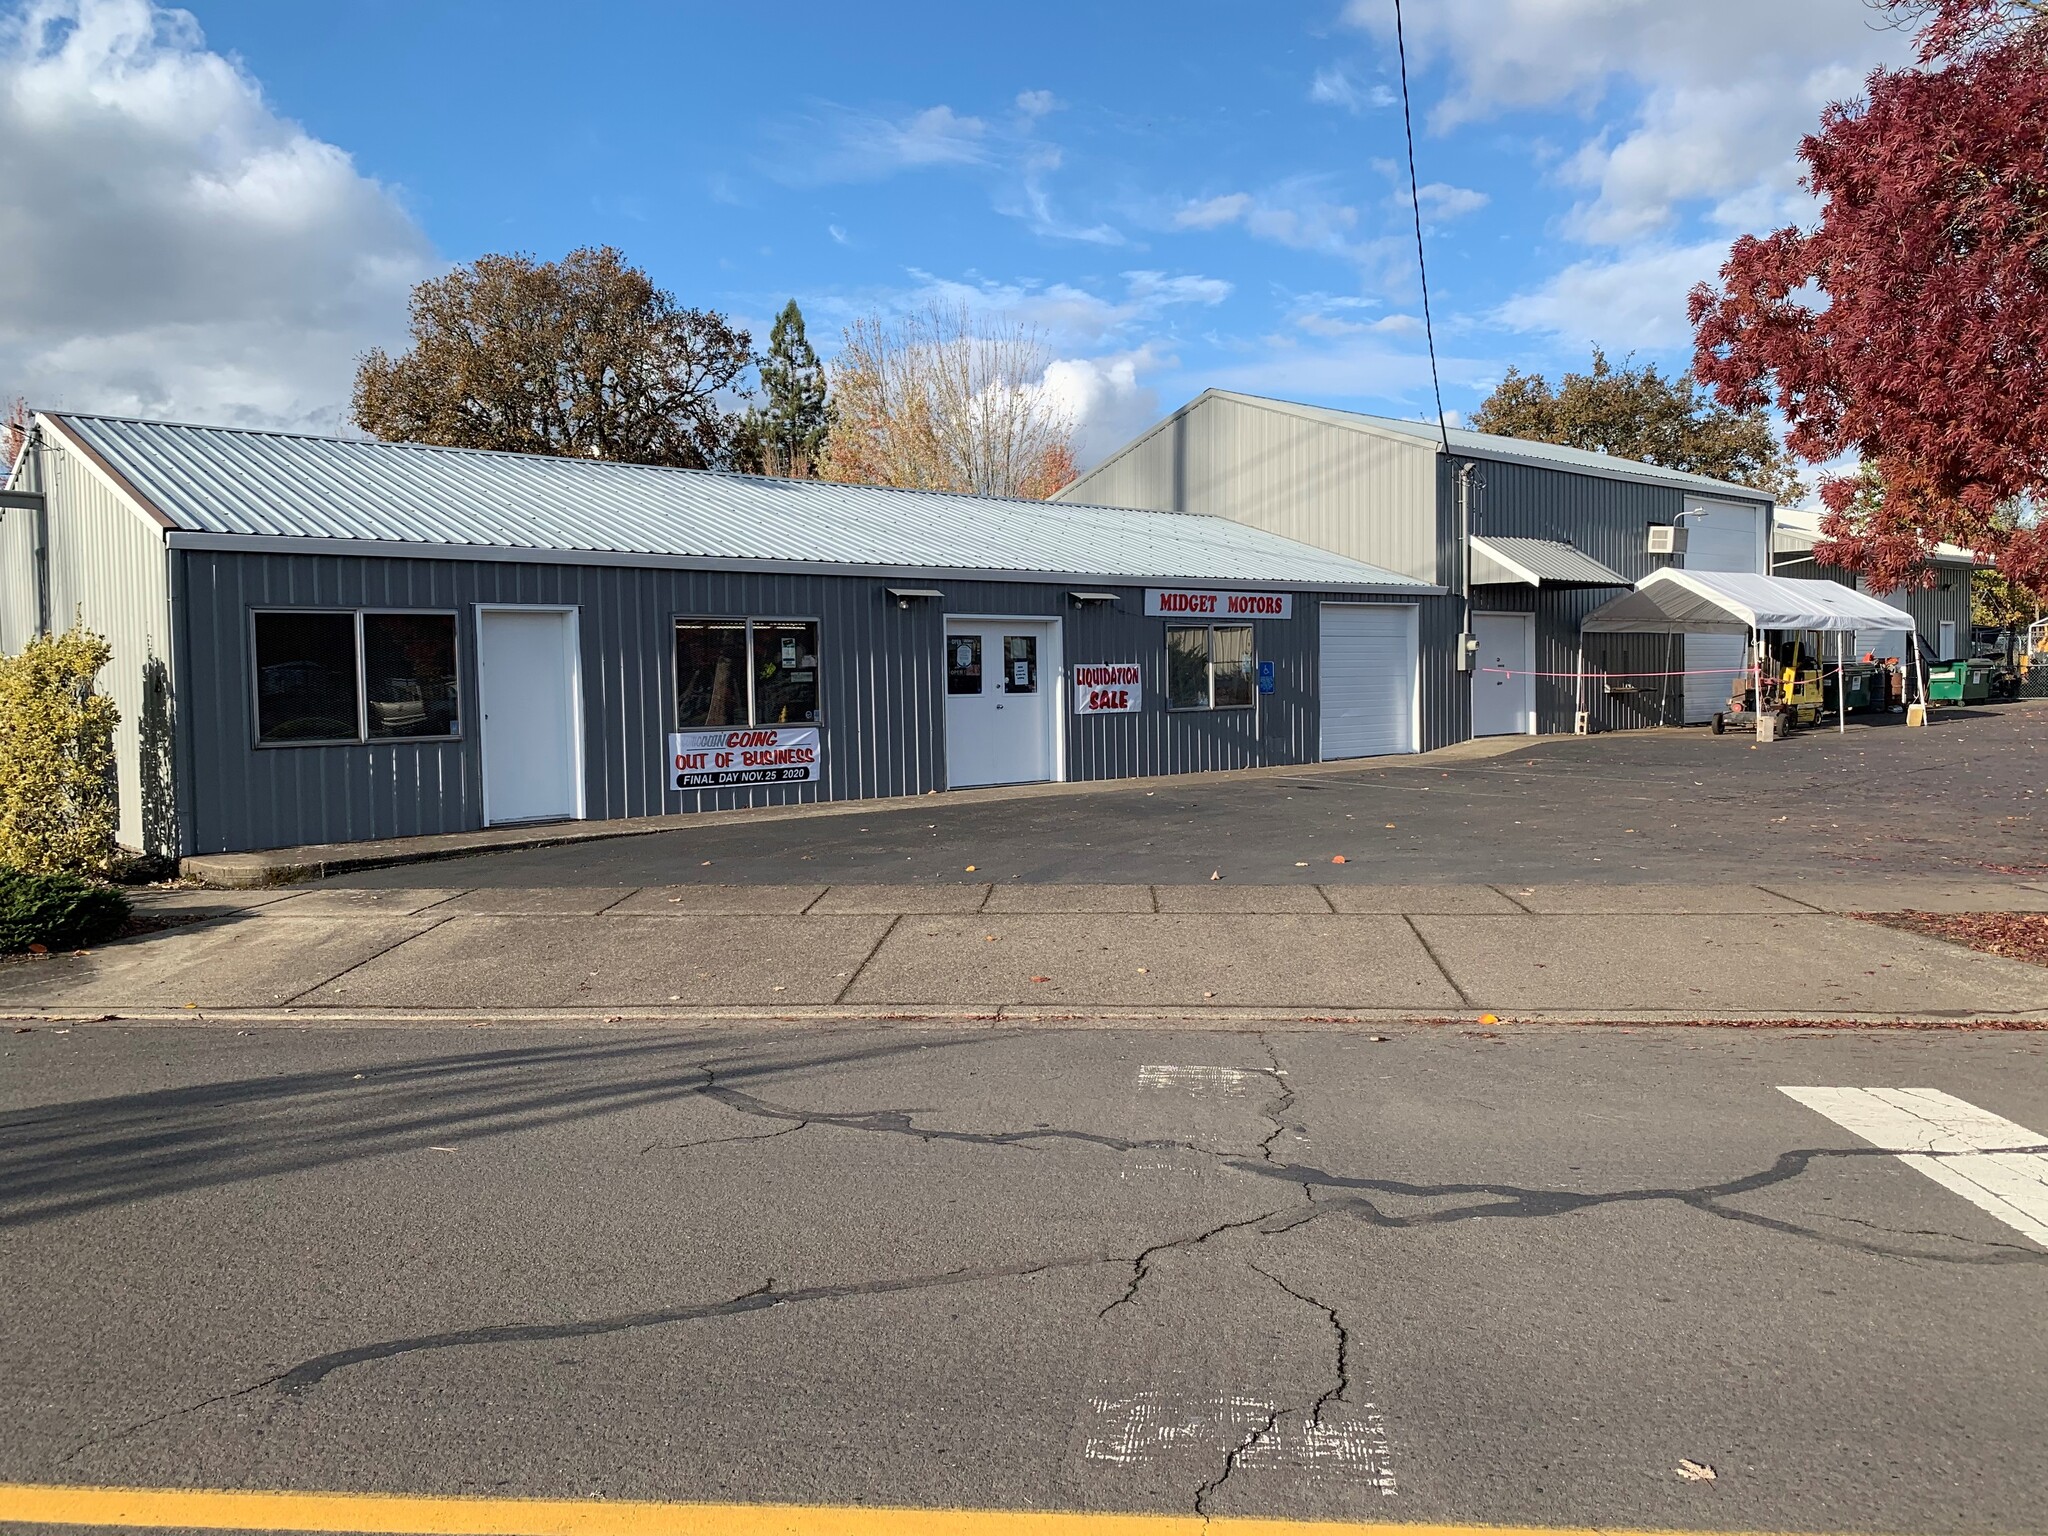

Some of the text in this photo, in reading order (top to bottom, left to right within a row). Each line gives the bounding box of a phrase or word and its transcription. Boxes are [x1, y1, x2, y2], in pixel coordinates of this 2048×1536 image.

[1160, 593, 1283, 614] MIDGET MOTORS
[1076, 666, 1139, 686] LIQUIDATION
[1089, 690, 1128, 710] SALE
[727, 731, 778, 748] GOING
[675, 748, 815, 770] OUT OF BUSINESS
[683, 774, 714, 785] FINAL
[719, 773, 739, 783] DAY
[782, 768, 805, 779] 2020
